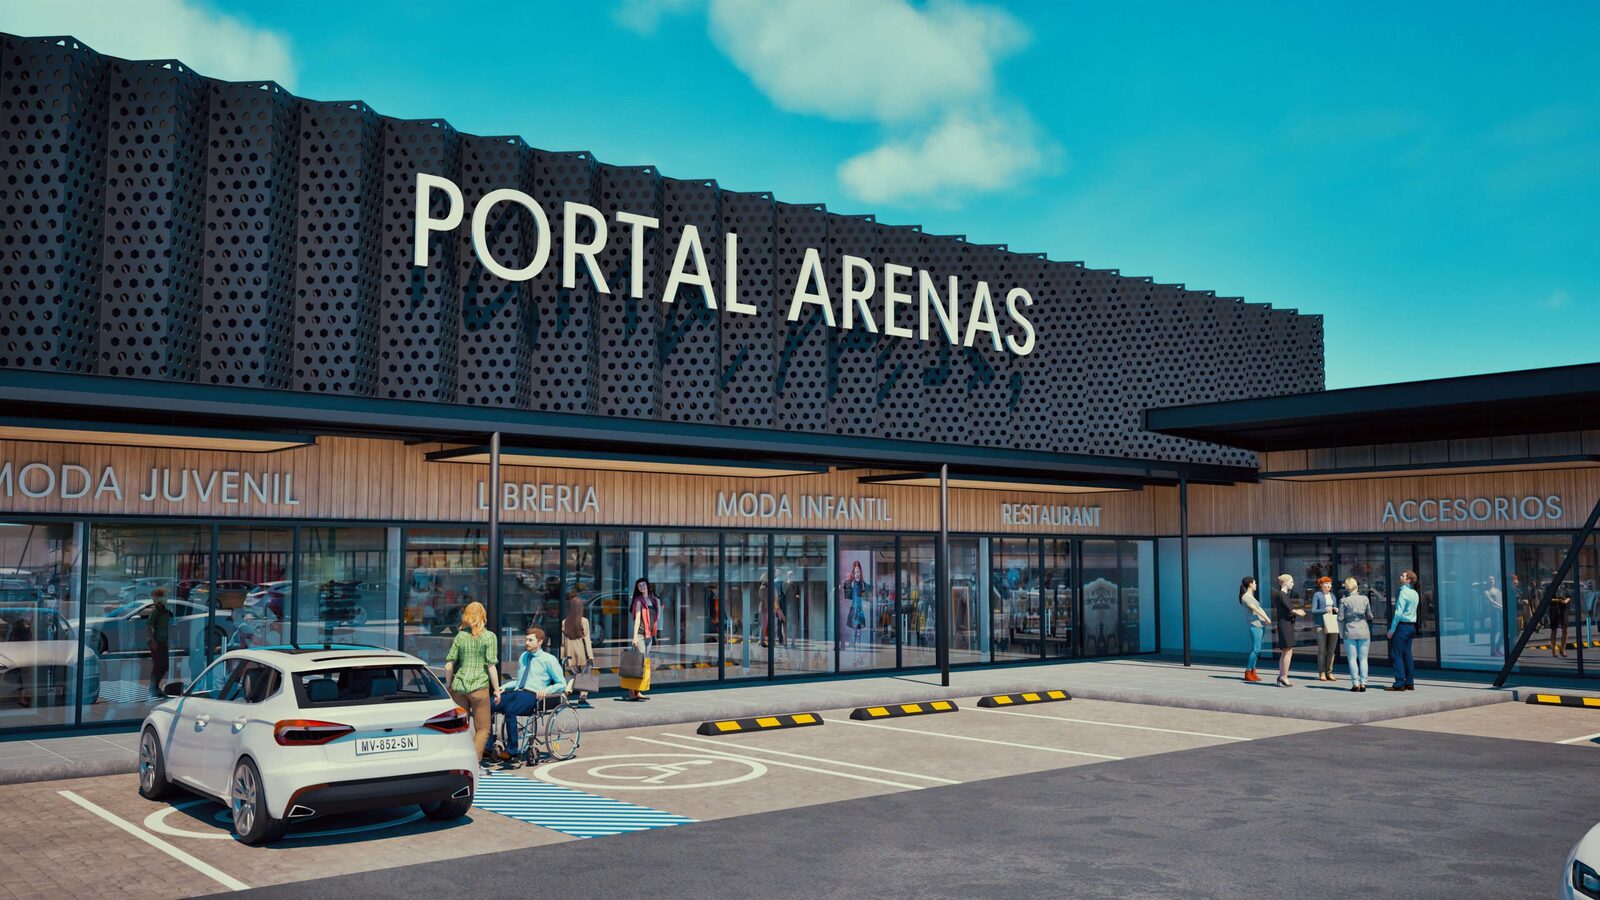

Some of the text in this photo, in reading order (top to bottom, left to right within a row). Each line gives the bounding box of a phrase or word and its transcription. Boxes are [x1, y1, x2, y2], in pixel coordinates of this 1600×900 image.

[414, 172, 1036, 356] PORTAL ARENAS
[140, 467, 300, 505] JUVENIL
[478, 481, 600, 513] LBRERIA
[717, 491, 892, 521] MODA INFANTIL
[1002, 503, 1102, 528] RESTAURANT
[1382, 495, 1563, 523] ACCESORIOS
[361, 737, 414, 752] MV-852-SN
